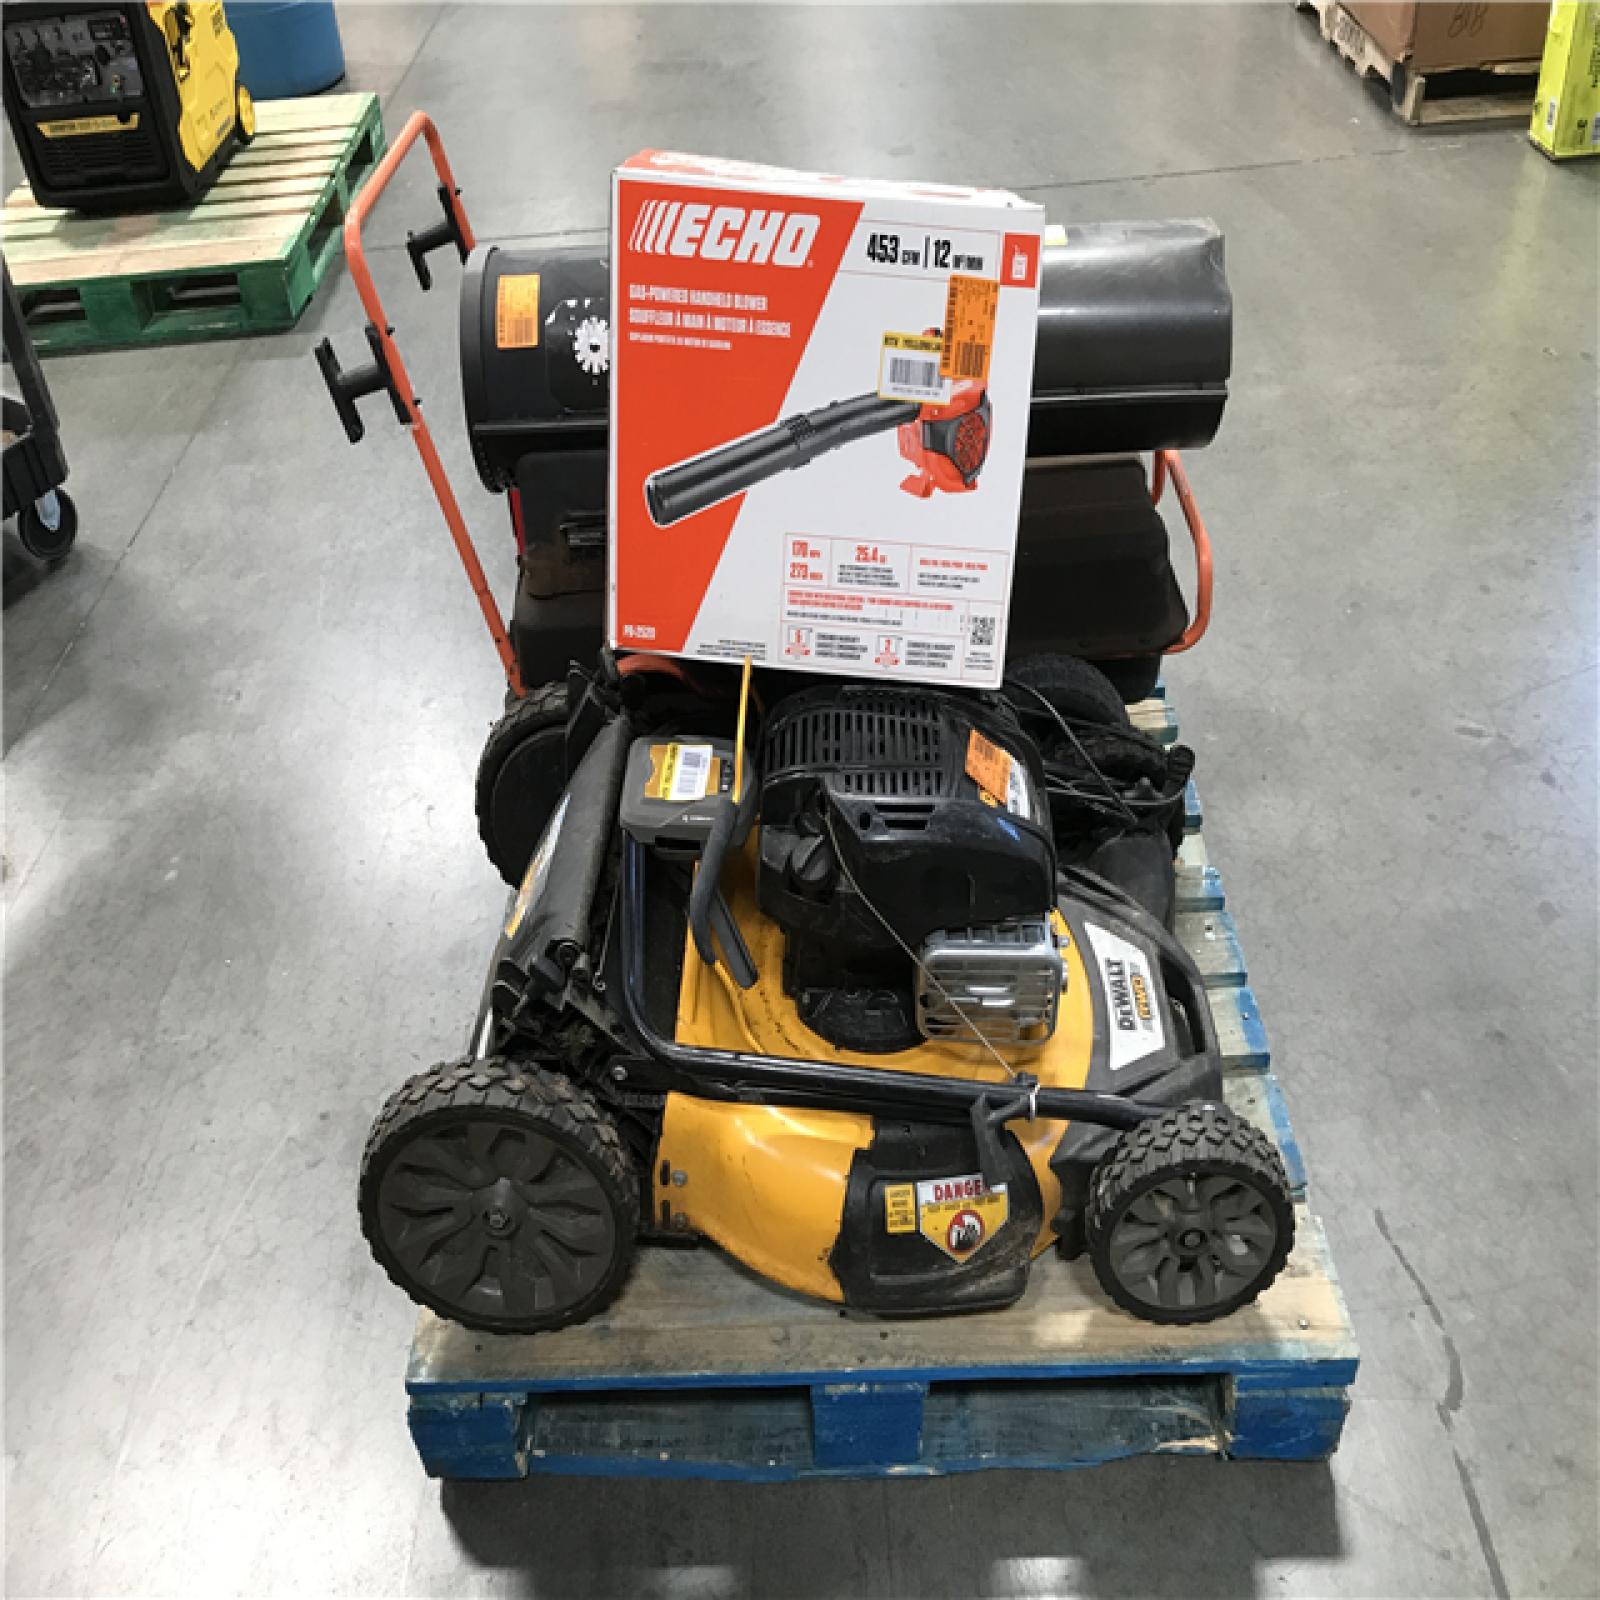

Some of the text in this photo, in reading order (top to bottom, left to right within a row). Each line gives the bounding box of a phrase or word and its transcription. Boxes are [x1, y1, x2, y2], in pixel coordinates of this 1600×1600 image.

[669, 204, 821, 268] ECHO
[866, 233, 900, 263] 453
[933, 239, 951, 268] 12
[1105, 957, 1137, 1030] DEWALT
